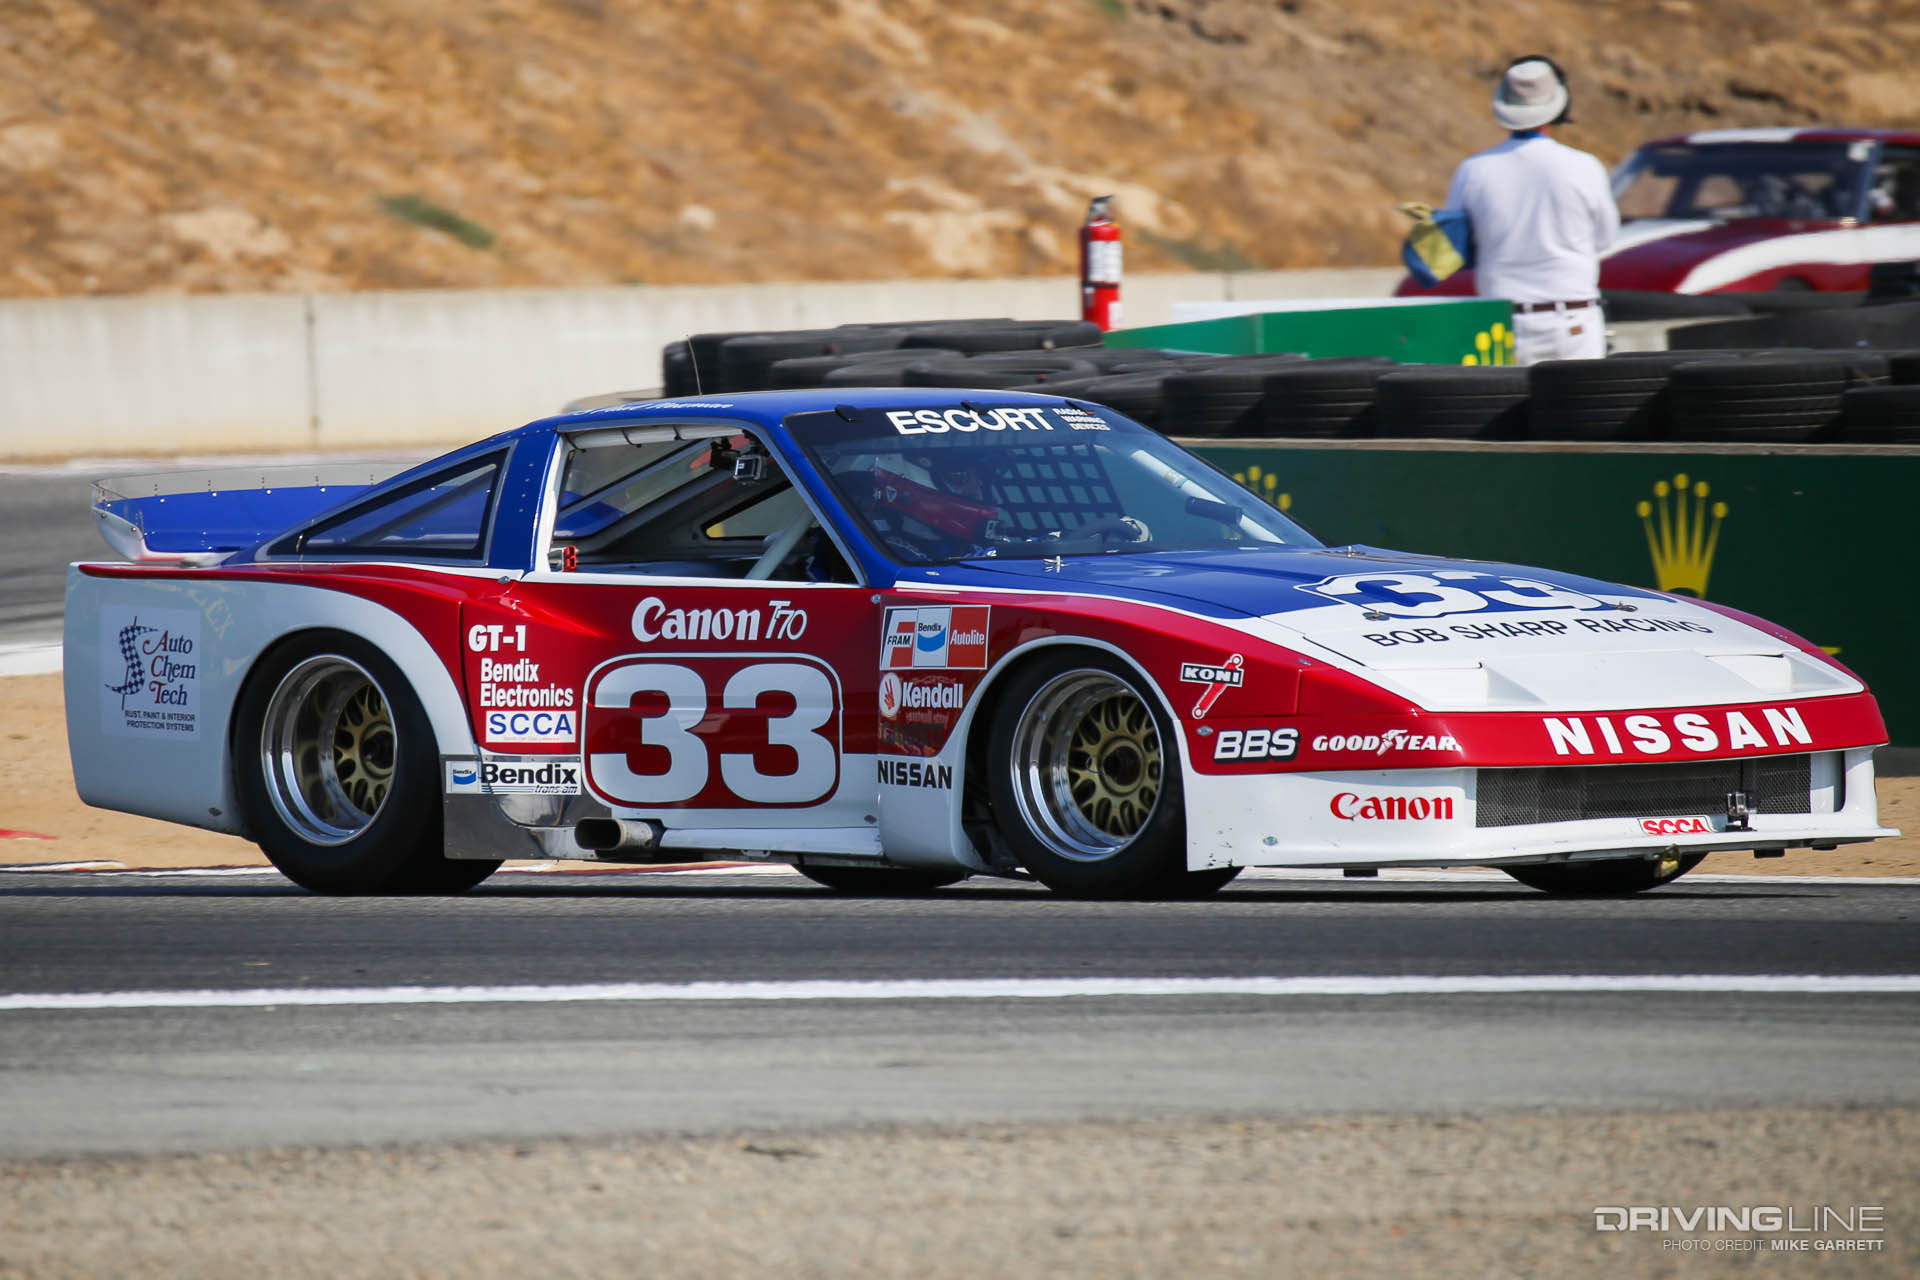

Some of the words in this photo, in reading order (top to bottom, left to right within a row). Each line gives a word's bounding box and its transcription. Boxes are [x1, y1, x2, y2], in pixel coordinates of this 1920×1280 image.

[886, 408, 1054, 435] ESCORT
[1315, 570, 1602, 617] 33
[631, 596, 761, 643] Canon
[765, 600, 808, 640] T70
[918, 622, 942, 632] Bendix
[1363, 627, 1450, 647] BOB
[1450, 620, 1568, 640] SHARP
[1575, 617, 1714, 634] RACING
[142, 629, 193, 655] Auto
[468, 624, 527, 652] GT-1
[887, 635, 911, 645] FRAM
[950, 628, 985, 645] Autolite
[151, 655, 196, 684] Chem
[480, 657, 539, 683] Bendix
[1184, 666, 1240, 683] KONI
[148, 680, 188, 706] Tech
[480, 683, 574, 708] Electronics
[902, 681, 964, 708] Kendall
[126, 720, 165, 729] PROTECTION
[166, 722, 194, 732] SYSTEMS
[143, 711, 160, 719] PAINT
[167, 712, 195, 721] INTERIOR
[489, 713, 573, 735] SCCA
[589, 663, 837, 804] 33
[1542, 707, 1813, 755] NISSAN
[1213, 727, 1299, 764] BBS
[481, 763, 577, 784] Bendix
[877, 760, 952, 789] NISSAN
[1330, 792, 1453, 820] Canon
[1643, 819, 1711, 835] SCCA
